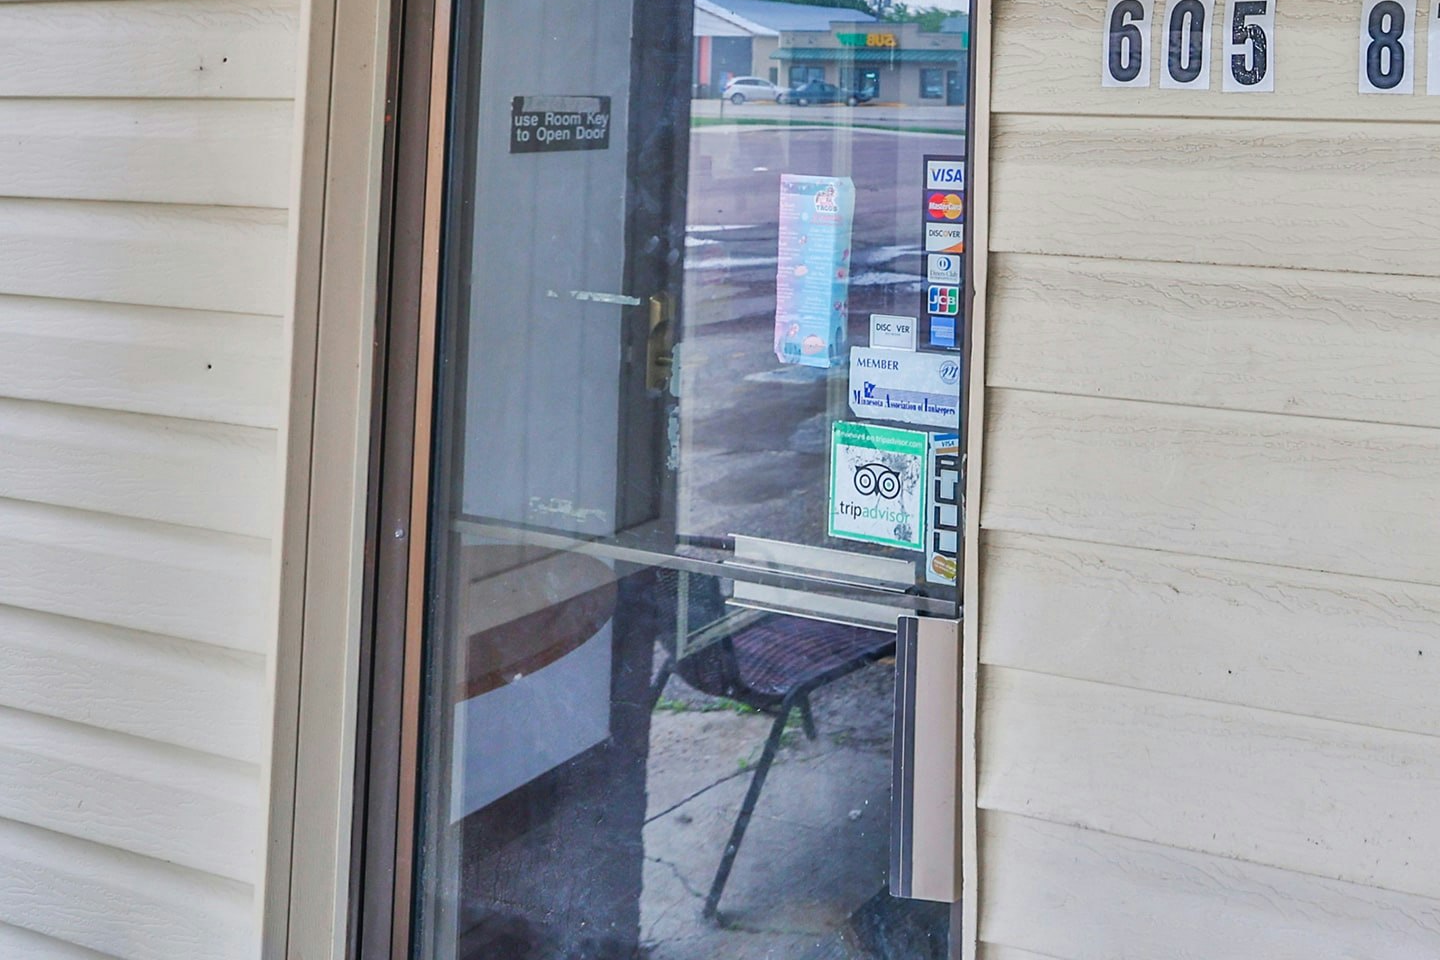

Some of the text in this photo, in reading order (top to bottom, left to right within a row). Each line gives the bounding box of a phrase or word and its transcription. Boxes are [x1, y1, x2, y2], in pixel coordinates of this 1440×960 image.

[514, 111, 609, 127] use Room Key
[516, 126, 606, 145] to Open Door
[931, 168, 963, 182] VISA
[928, 229, 961, 238] DISCOVER
[929, 296, 956, 306] JCB
[857, 357, 899, 370] MEMBER
[840, 501, 911, 523] tripadvisor
